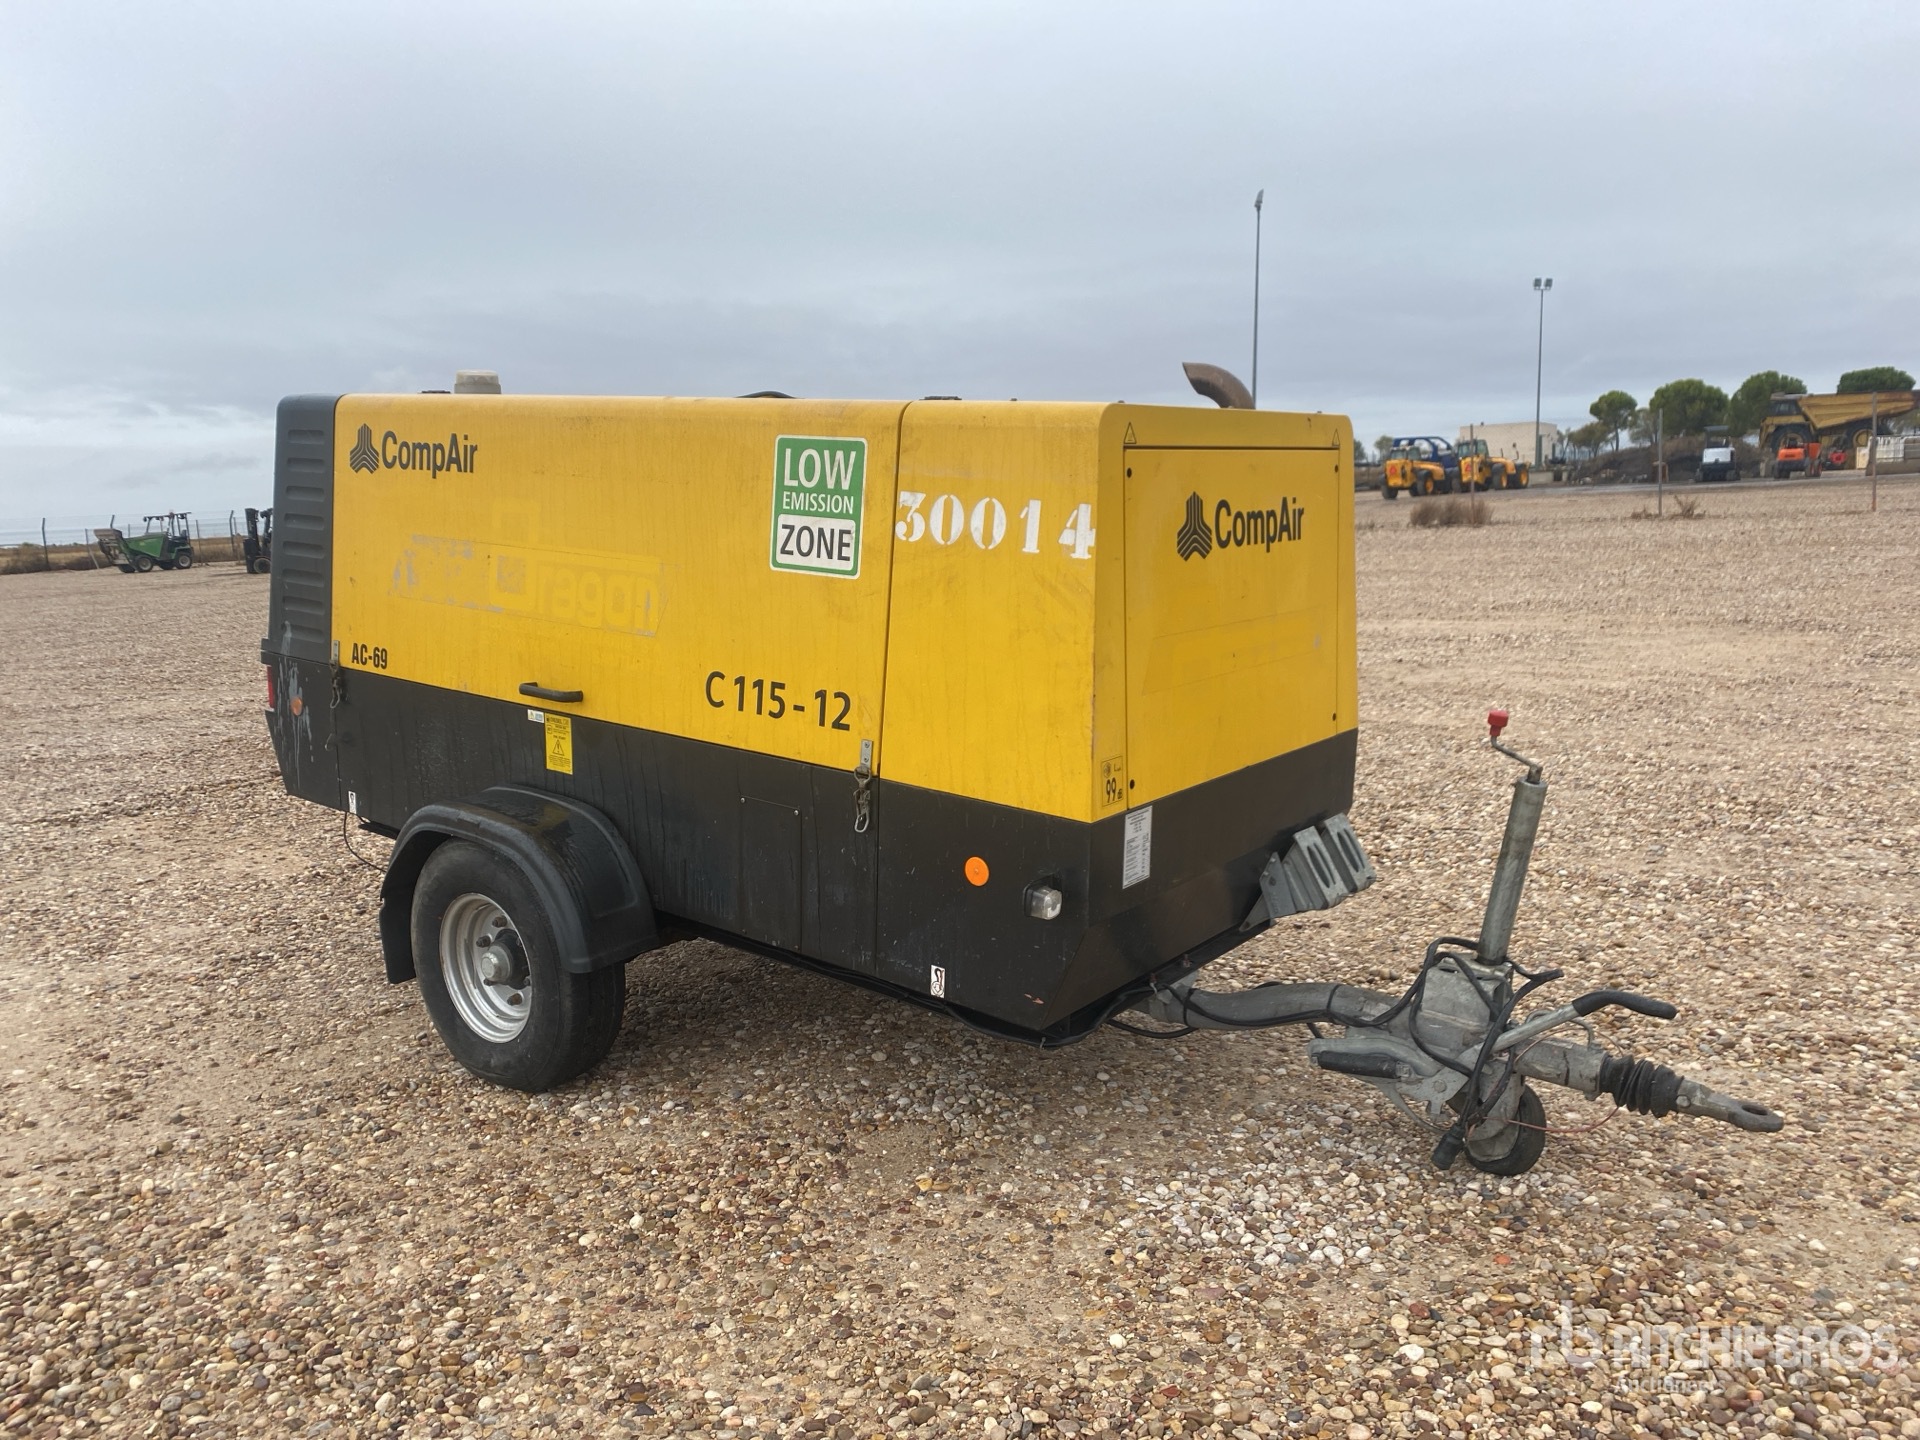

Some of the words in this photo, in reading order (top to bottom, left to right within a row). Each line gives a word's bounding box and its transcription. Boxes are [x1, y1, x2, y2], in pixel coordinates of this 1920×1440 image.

[381, 430, 478, 479] CompAir
[784, 448, 857, 490] LOW
[782, 491, 854, 515] EMISSION
[779, 523, 852, 562] ZONE
[895, 491, 1096, 559] 30014
[1214, 496, 1305, 553] CompAir
[351, 642, 388, 669] AC-69
[1105, 777, 1117, 803] 99
